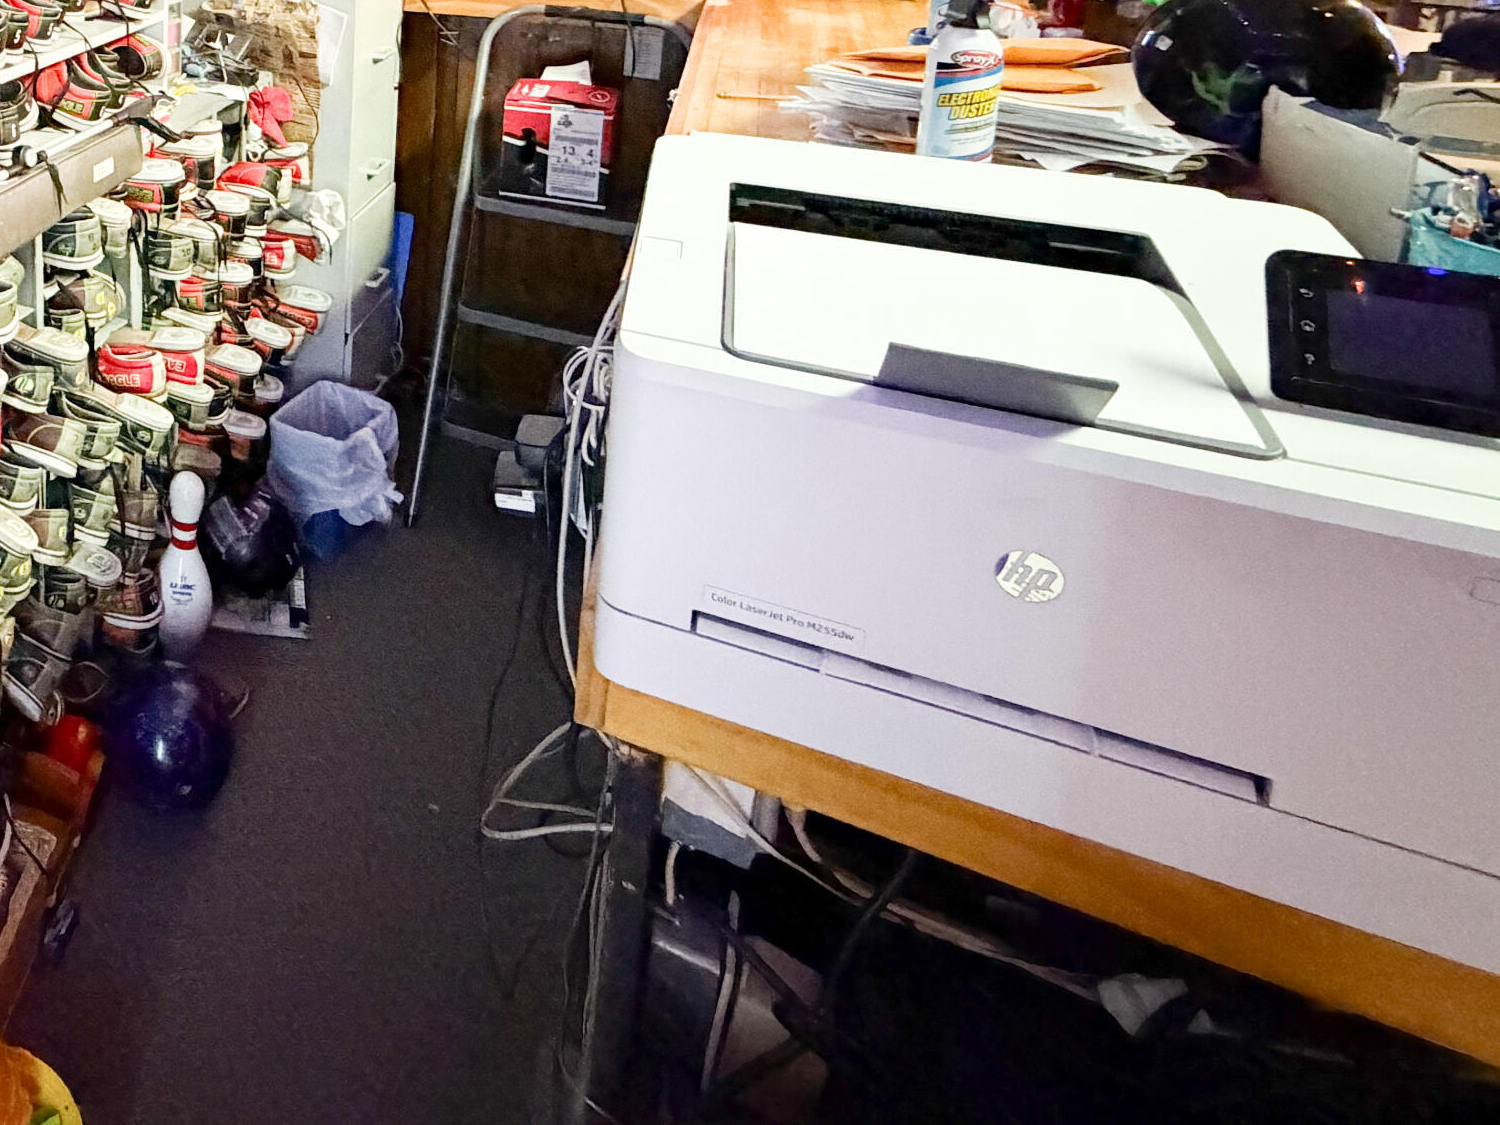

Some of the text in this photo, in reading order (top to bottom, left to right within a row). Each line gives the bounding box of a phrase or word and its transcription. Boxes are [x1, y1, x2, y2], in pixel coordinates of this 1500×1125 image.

[999, 550, 1062, 602] hp
[710, 592, 855, 642] Color LaserJet Pro M255dw
